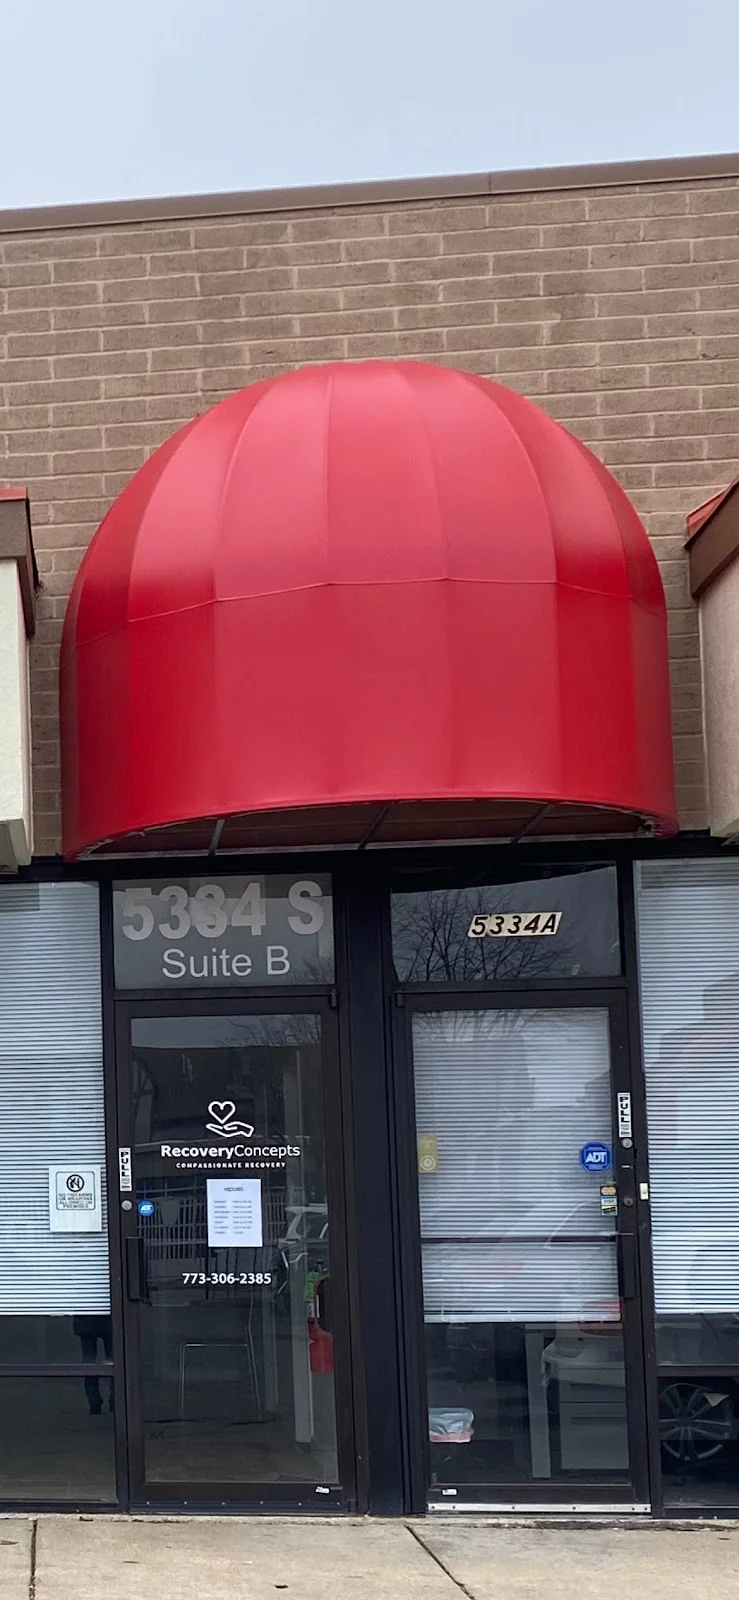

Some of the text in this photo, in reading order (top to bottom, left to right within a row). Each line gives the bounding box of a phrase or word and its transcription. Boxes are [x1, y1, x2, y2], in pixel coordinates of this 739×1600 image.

[288, 880, 325, 935] S
[471, 913, 557, 935] 5334A
[162, 945, 291, 979] Suite B
[620, 1096, 630, 1123] PULL
[120, 1151, 130, 1177] PULL
[585, 1151, 607, 1163] ADT
[181, 1273, 272, 1285] 773-306-2385
